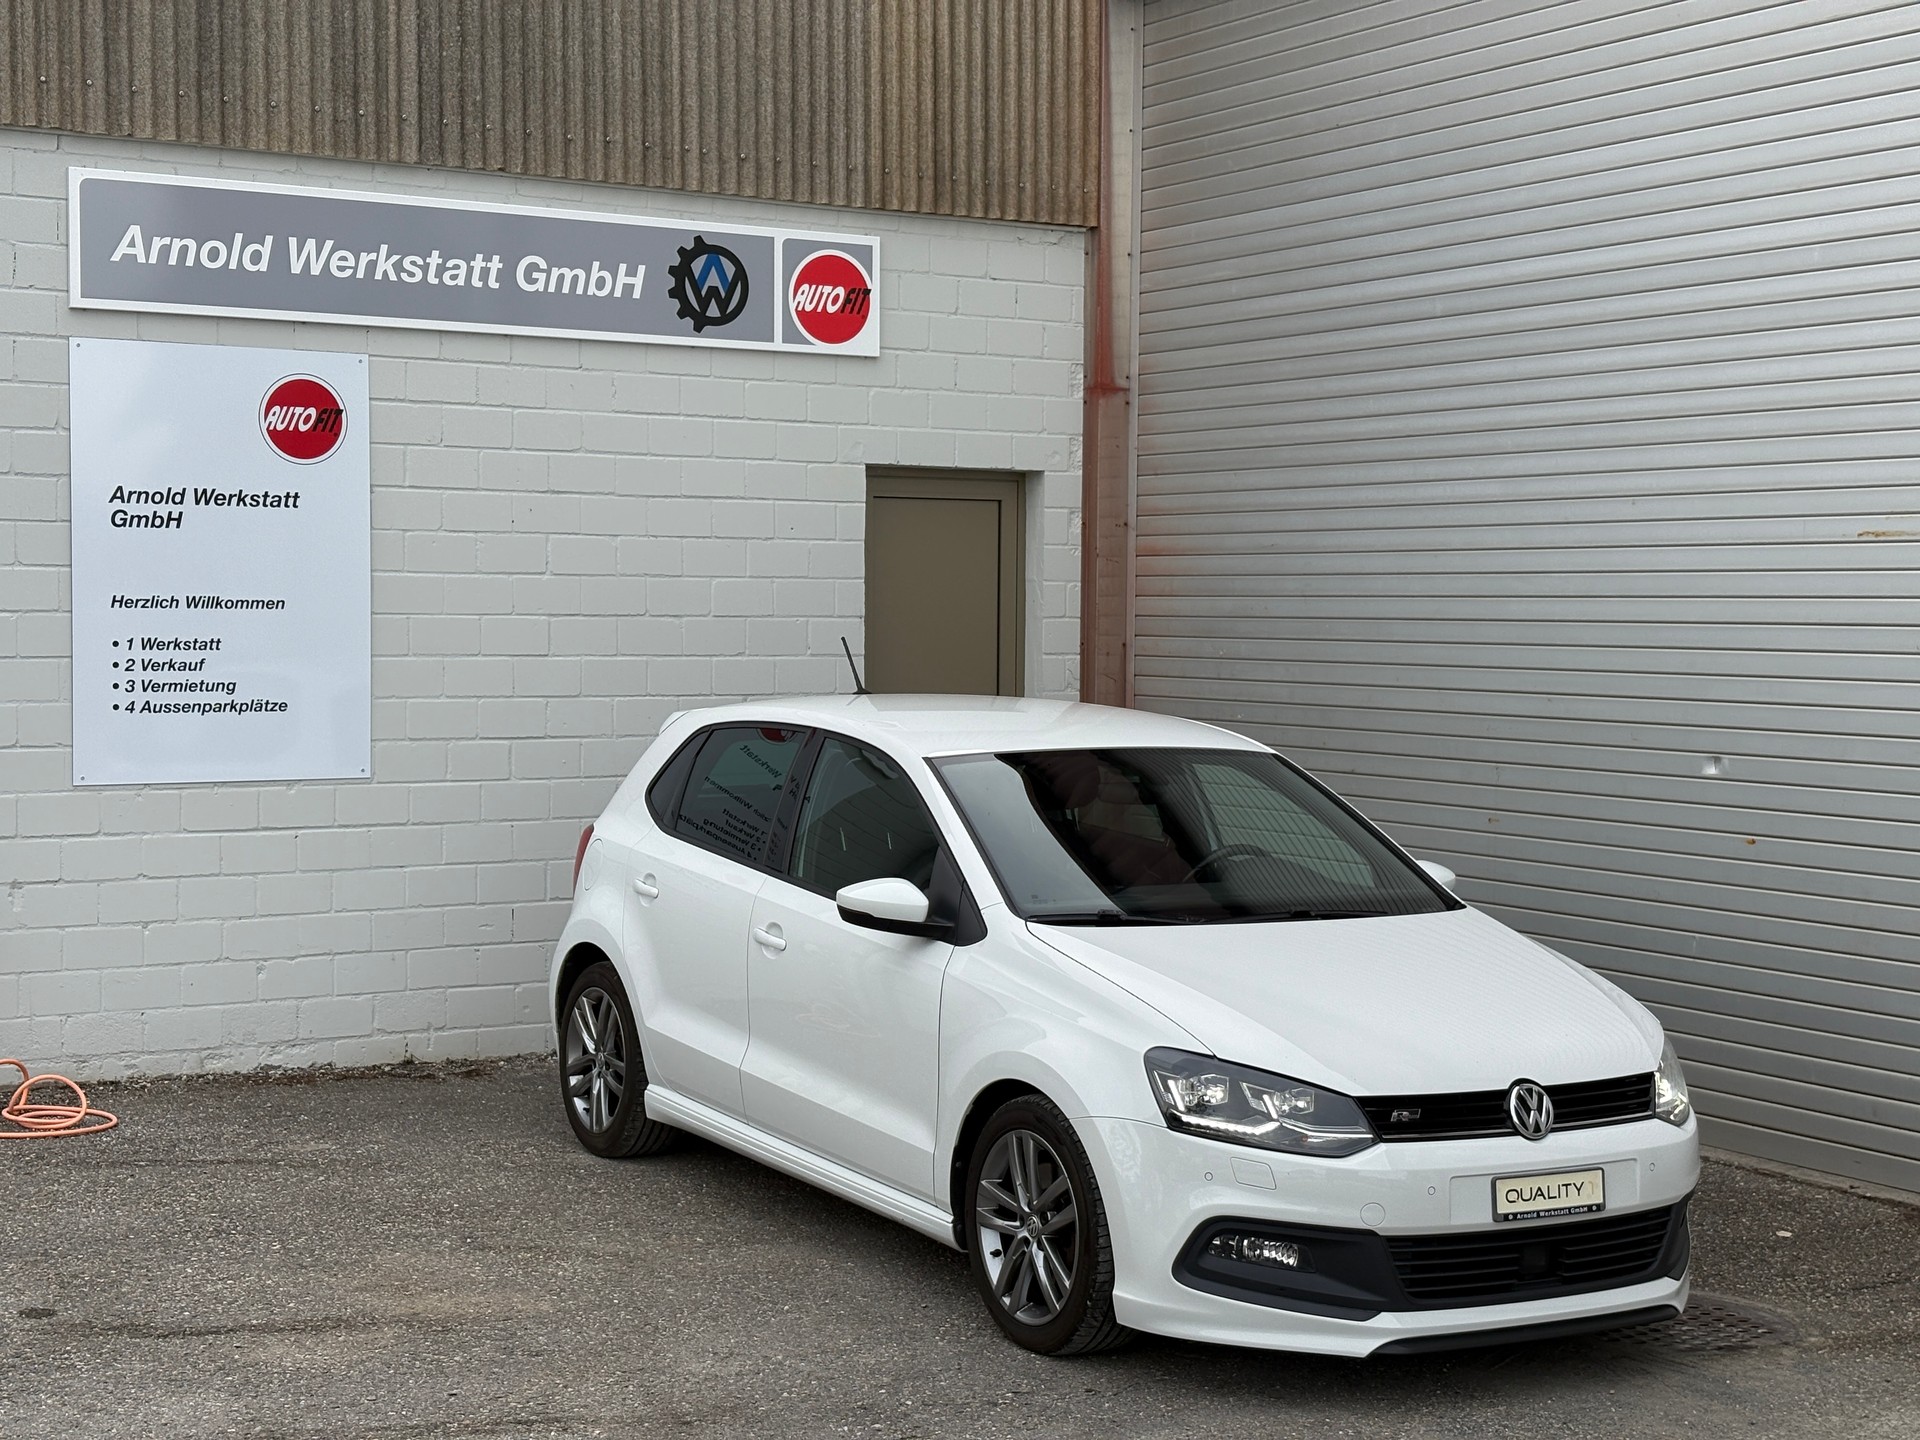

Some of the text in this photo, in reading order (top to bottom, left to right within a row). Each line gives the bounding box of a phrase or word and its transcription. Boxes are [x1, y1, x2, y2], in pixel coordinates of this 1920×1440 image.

[109, 224, 647, 299] Arnold Werkstatt GmbH
[792, 283, 872, 316] AUTOFIT
[264, 404, 344, 433] AUTOFIT
[108, 485, 300, 509] Arnold Werkstatt
[110, 509, 184, 529] GmbH
[110, 594, 286, 610] Herzlich Willkommen
[126, 637, 222, 651] 1 Werkstatt
[124, 657, 207, 672] 2 Verkauf
[124, 678, 237, 696] 3 Vermietung
[124, 698, 288, 716] 4 Aussenparkplätze
[1505, 1181, 1585, 1204] QUALITY
[1516, 1206, 1588, 1219] Arnold Werkstatt GmbH
